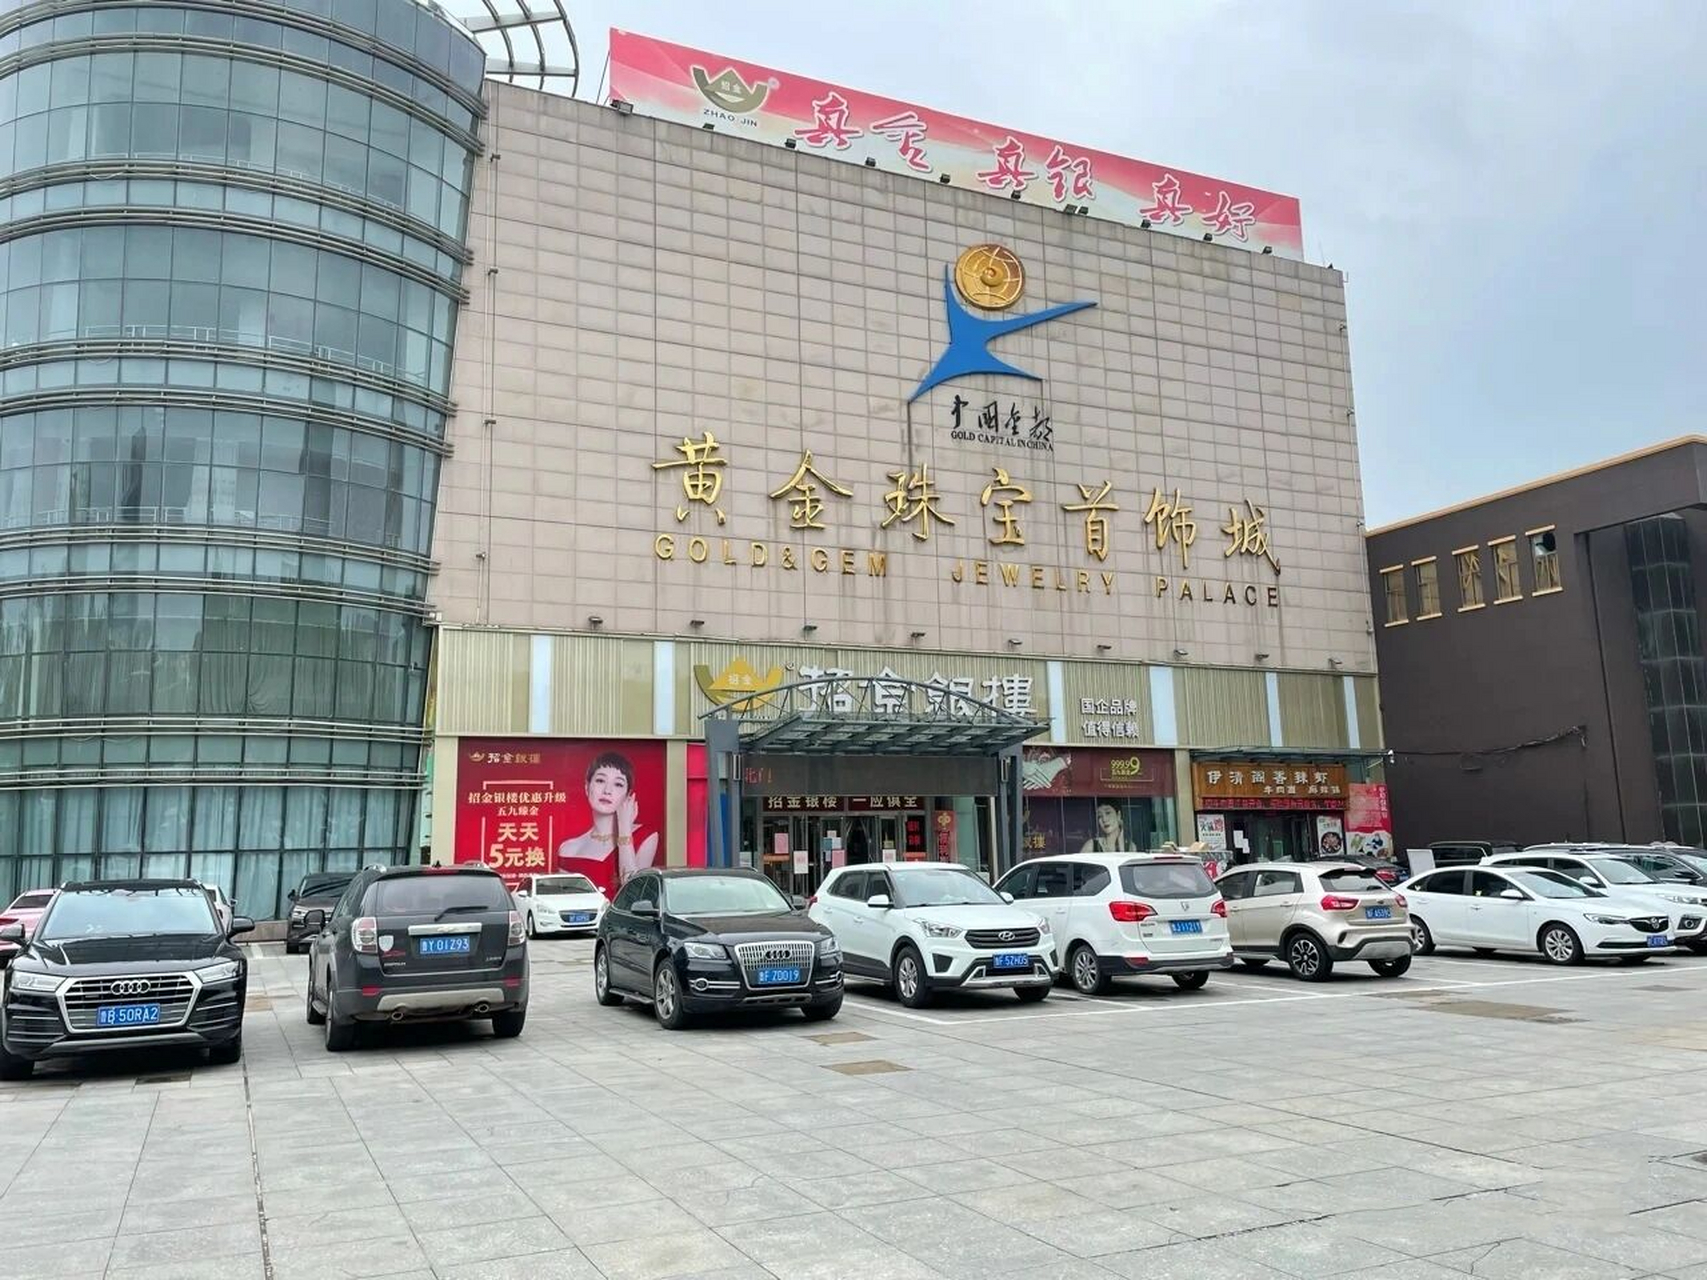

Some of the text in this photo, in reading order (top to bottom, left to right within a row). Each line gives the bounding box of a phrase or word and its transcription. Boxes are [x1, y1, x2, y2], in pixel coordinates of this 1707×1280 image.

[703, 108, 758, 128] ZHAO JIN
[951, 430, 976, 442] GOLD
[977, 433, 1017, 447] CAPITAL
[1026, 440, 1054, 453] CHINA
[651, 430, 1282, 577] 黄金珠宝首饰城
[654, 533, 1280, 608] GOLD&GEM JEWELRY PALACE
[1080, 698, 1138, 716] 国企品牌
[1082, 720, 1140, 738] 值得信赖
[468, 791, 567, 804] 招金银楼优惠升级
[498, 822, 540, 842] 天天
[489, 843, 546, 868] 5元换
